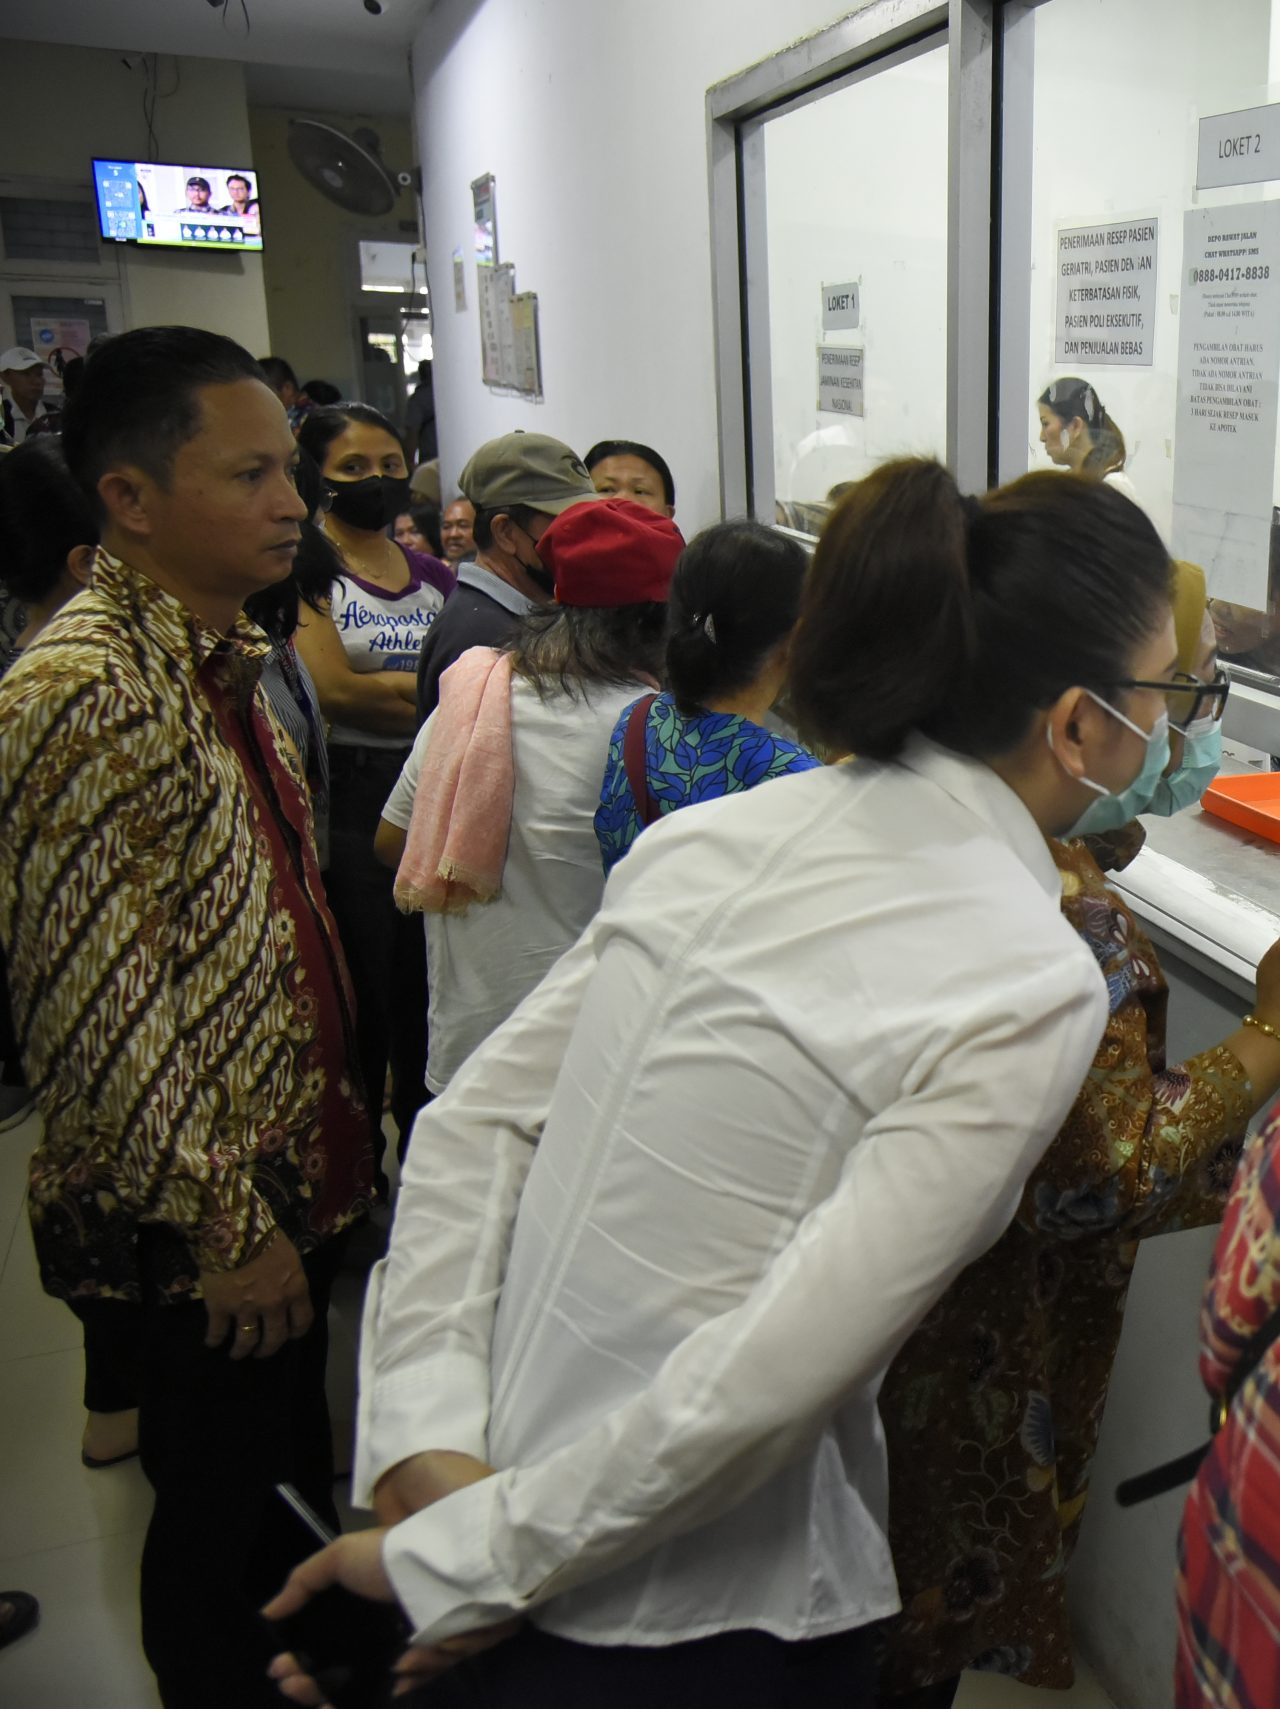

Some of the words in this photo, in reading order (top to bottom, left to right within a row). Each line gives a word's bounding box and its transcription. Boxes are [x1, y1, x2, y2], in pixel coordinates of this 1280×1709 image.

[1219, 136, 1252, 158] LOKET
[1254, 134, 1260, 153] 2
[1060, 232, 1104, 250] PENERIMAAN
[1107, 229, 1127, 245] RESEP
[1129, 226, 1154, 242] PASIEN
[1241, 232, 1257, 241] JALAN
[1061, 261, 1093, 276] GERIATRI,
[1095, 259, 1119, 273] PASIEN
[1194, 266, 1270, 282] 0888-0417-8838
[1069, 287, 1120, 302] KETERBATASAN
[1122, 285, 1140, 301] FISIK,
[828, 294, 849, 311] LOKET
[851, 294, 855, 308] 1
[1065, 315, 1087, 328] PASIEN
[1090, 315, 1104, 328] POLI
[1106, 313, 1143, 329] EKSEKUTIF,
[1065, 342, 1078, 354] DAN
[1081, 342, 1119, 354] PENJUALAN
[1121, 342, 1142, 355] BEBAS
[1245, 344, 1263, 352] HARUS
